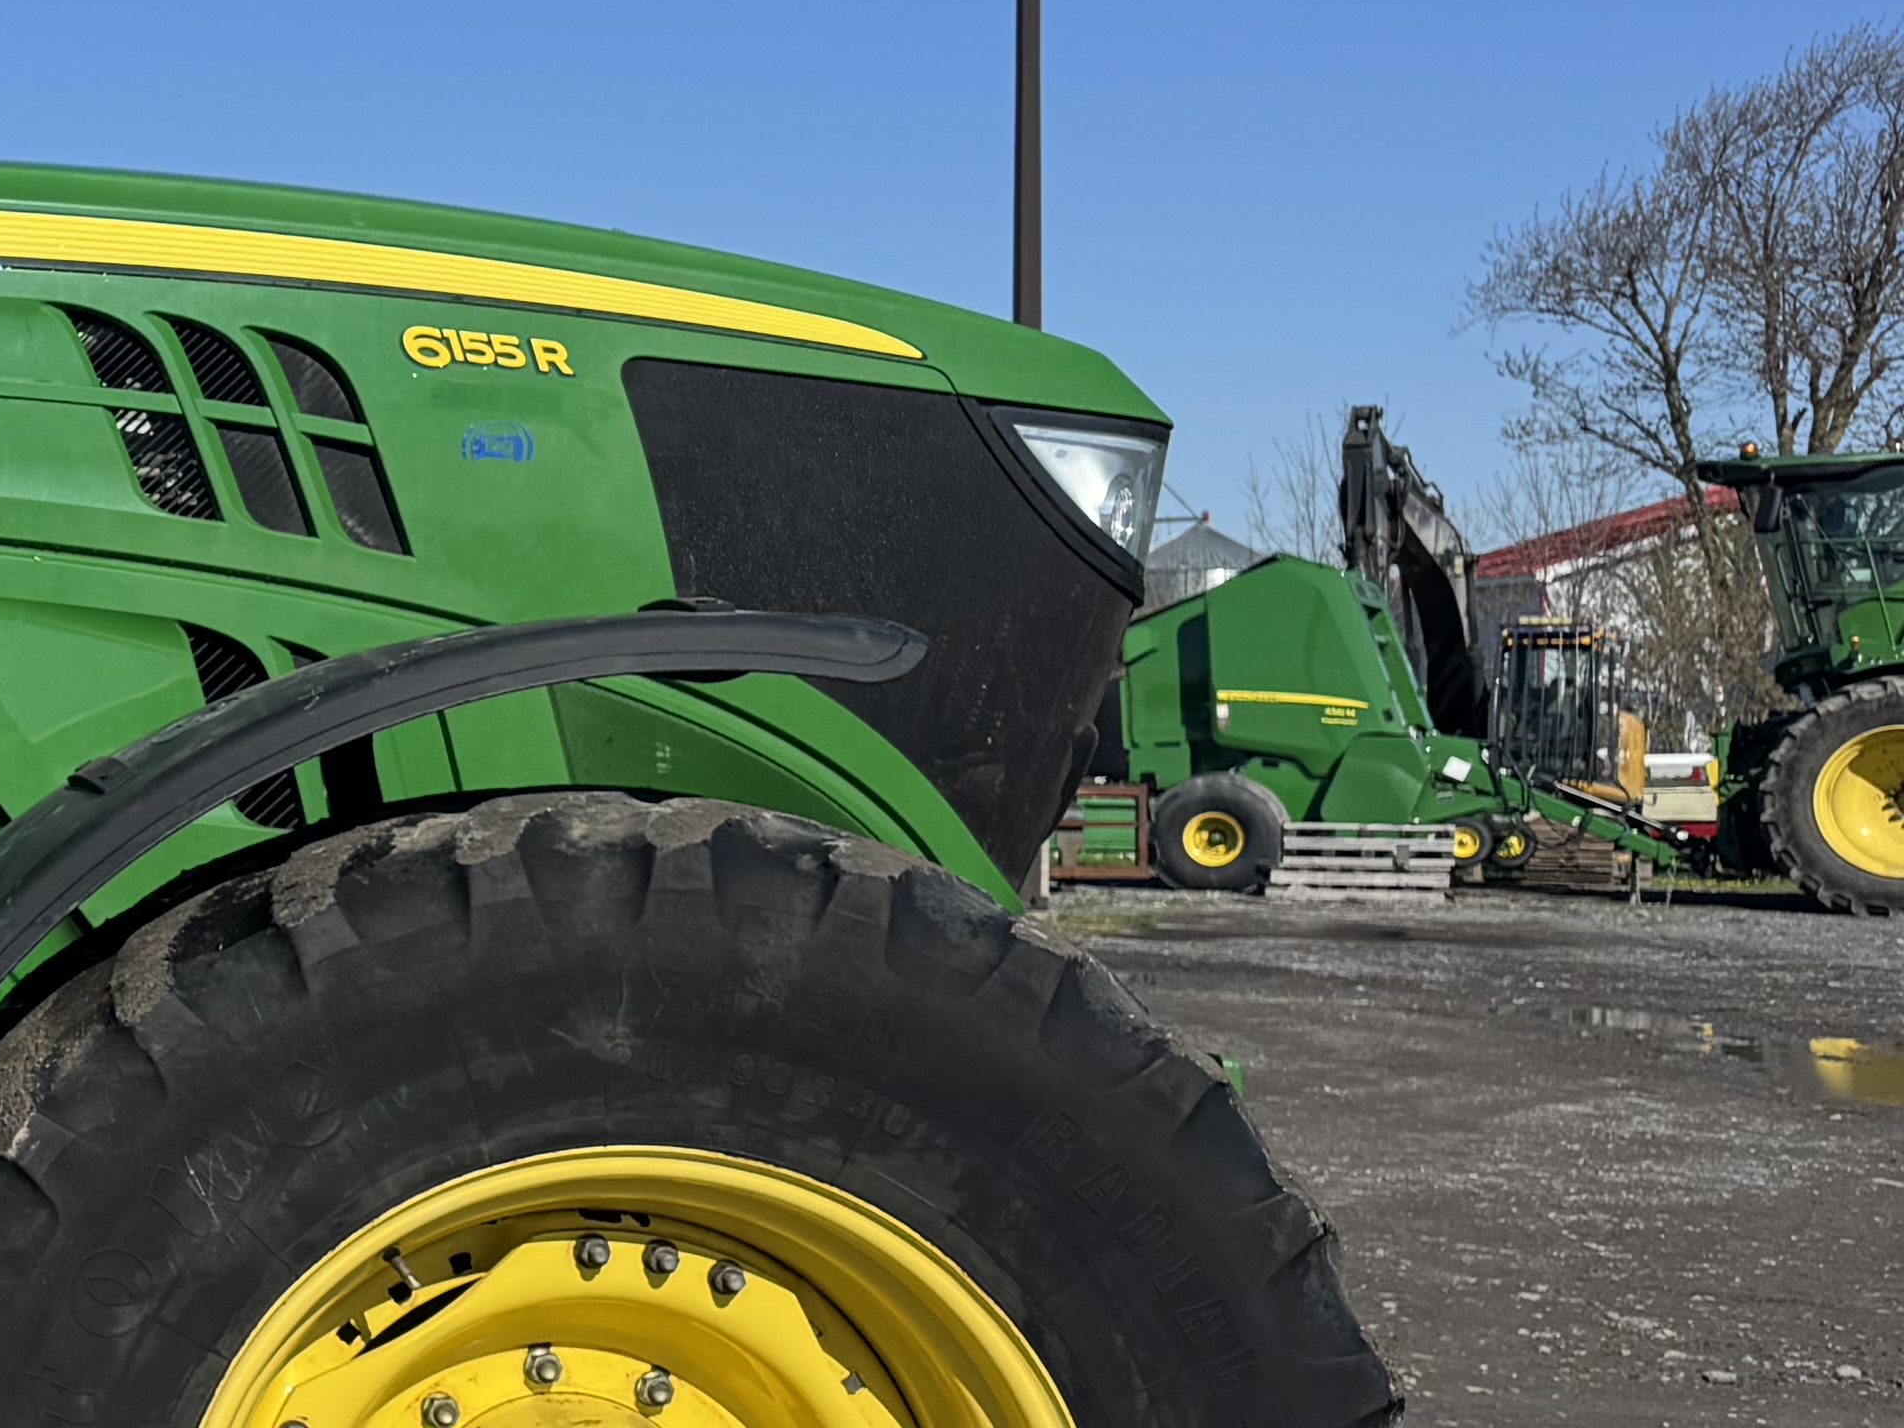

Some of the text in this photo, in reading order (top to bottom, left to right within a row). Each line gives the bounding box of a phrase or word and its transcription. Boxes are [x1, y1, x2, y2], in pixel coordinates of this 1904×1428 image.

[402, 325, 575, 376] 6155 R
[1021, 1106, 1270, 1401] RADIAL
